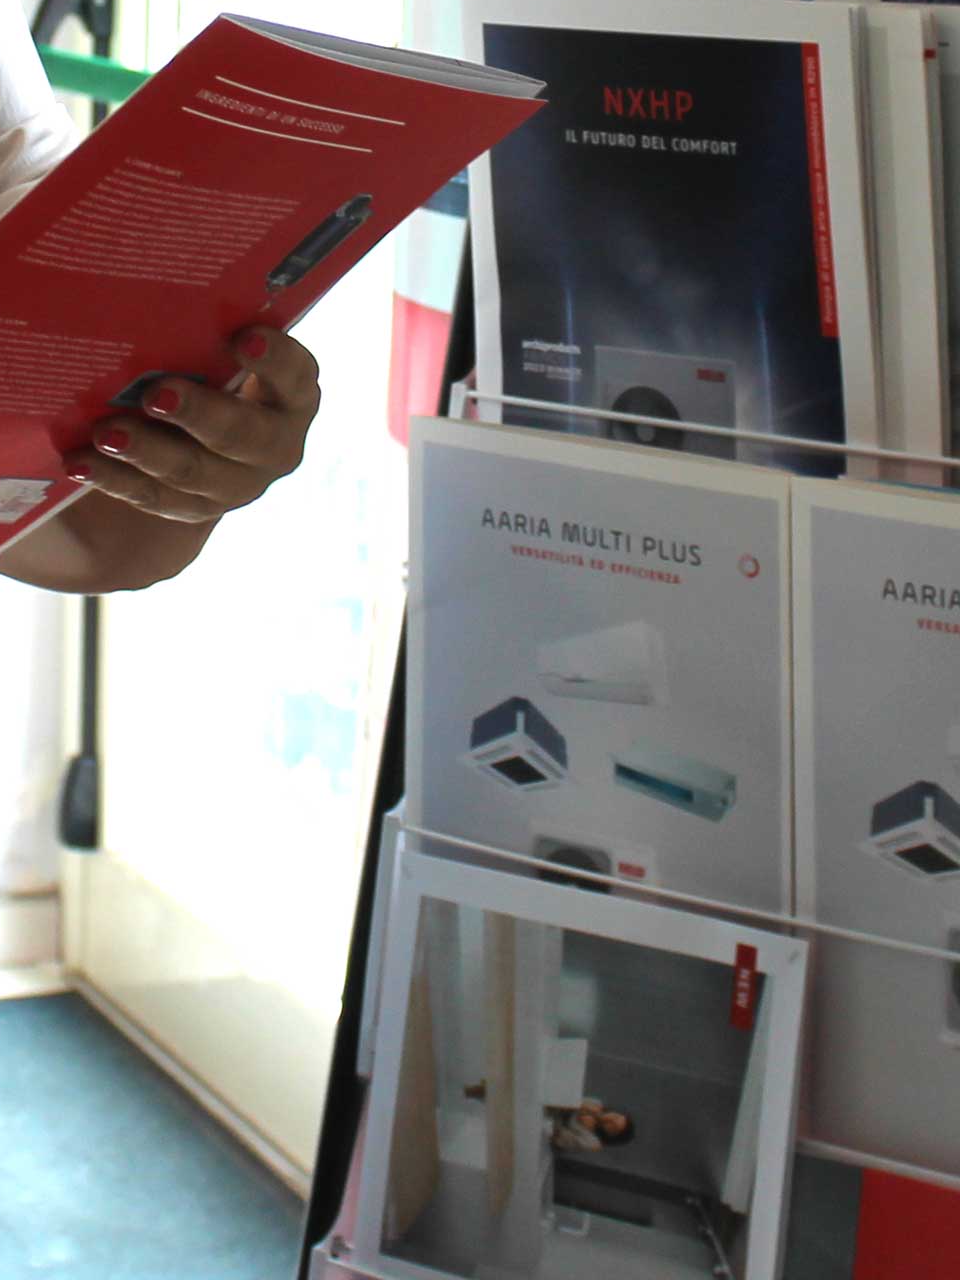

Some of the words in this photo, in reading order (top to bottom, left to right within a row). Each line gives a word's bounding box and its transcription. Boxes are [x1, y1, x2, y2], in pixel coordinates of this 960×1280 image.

[603, 85, 694, 121] NXHP
[565, 129, 578, 143] IL
[582, 130, 636, 148] FUTURO
[641, 134, 667, 151] DEL
[671, 137, 737, 156] COMFORT
[481, 507, 552, 540] AARIA
[560, 521, 632, 554] MULTI
[641, 535, 703, 568] PLUS
[882, 578, 960, 611] AARIA
